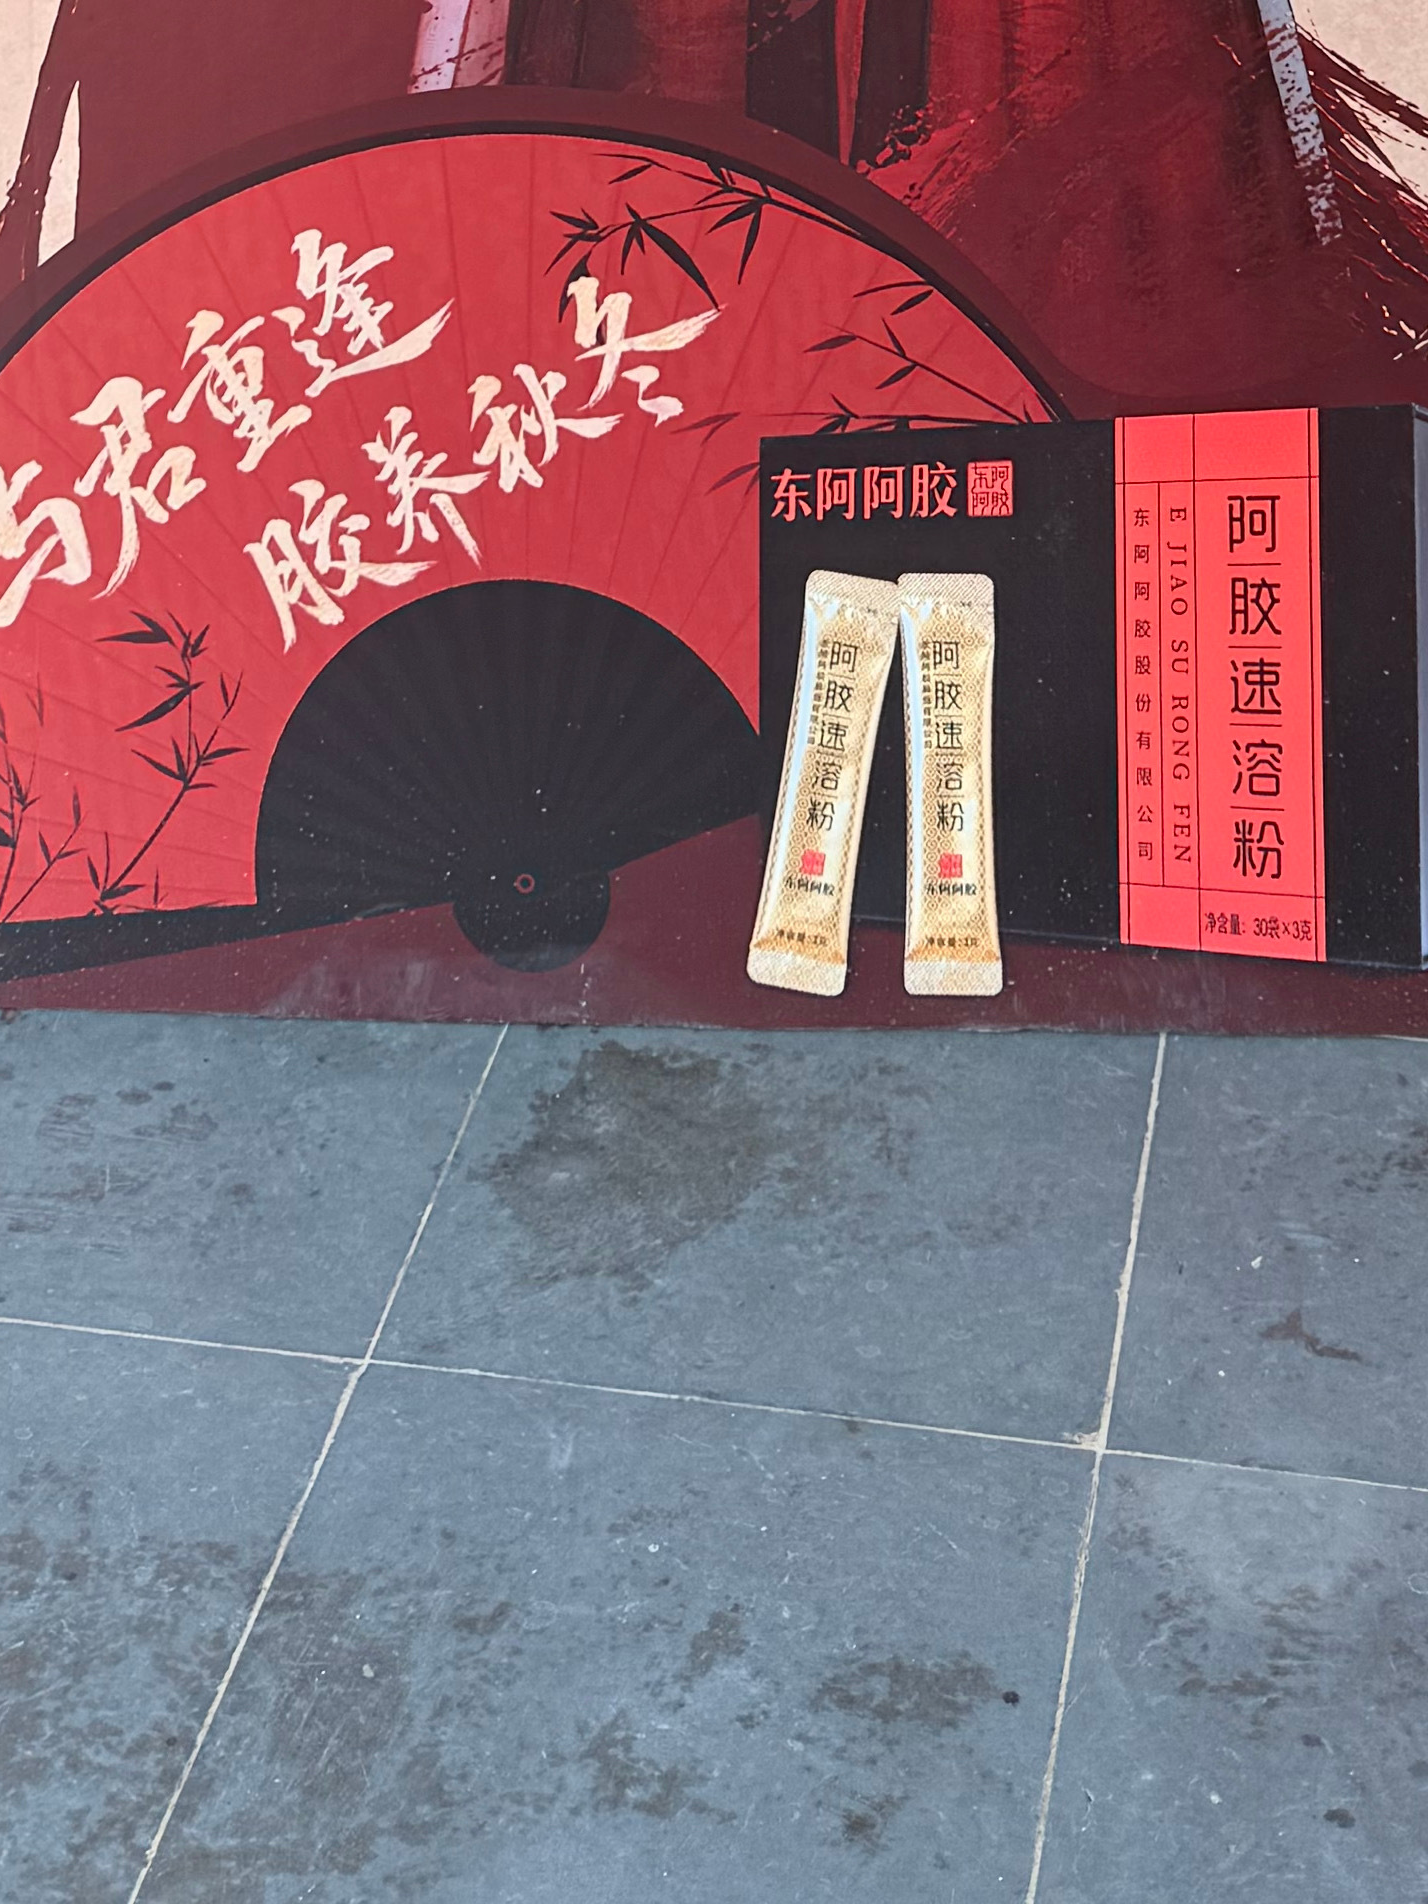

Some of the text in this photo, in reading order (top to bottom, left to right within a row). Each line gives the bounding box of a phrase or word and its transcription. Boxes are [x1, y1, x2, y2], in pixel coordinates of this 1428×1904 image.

[243, 276, 728, 654] 胶养秋冬
[770, 461, 959, 522] 东阿阿胶
[806, 641, 860, 833] 阿胶速溶粉
[932, 640, 964, 833] 阿胶速溶粉
[1132, 507, 1154, 862] 东阿阿胶股份有限公司
[1167, 506, 1192, 864] E JIAO SU RONG FEN
[1226, 494, 1283, 880] 阿胶速溶粉
